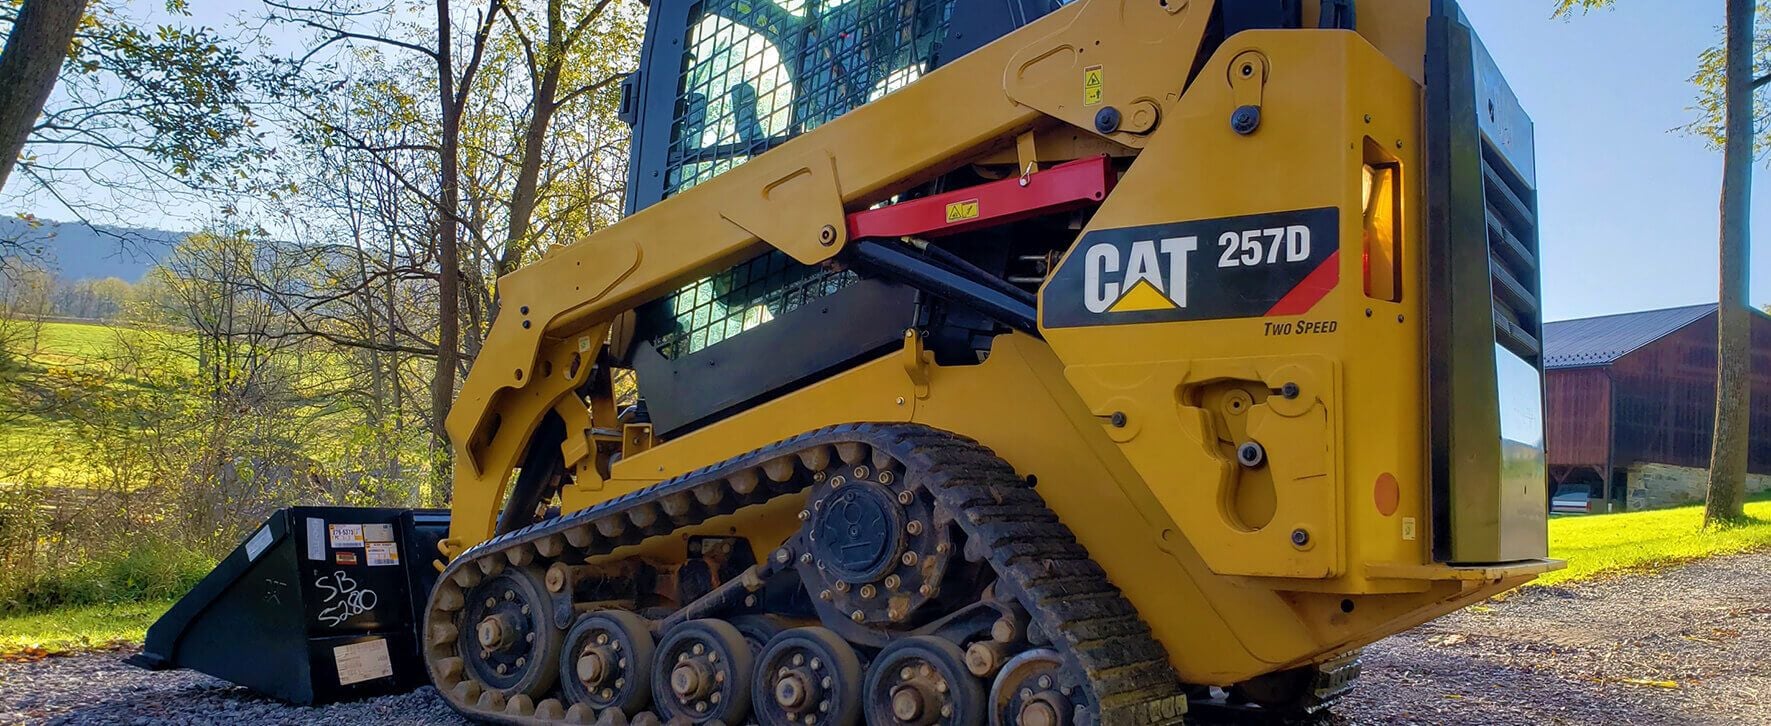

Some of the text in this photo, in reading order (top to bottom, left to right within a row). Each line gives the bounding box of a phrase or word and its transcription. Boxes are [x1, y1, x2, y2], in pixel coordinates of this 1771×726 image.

[1084, 225, 1311, 314] CAT 257D
[1264, 320, 1338, 337] TWO SPEED
[315, 570, 357, 602] SB
